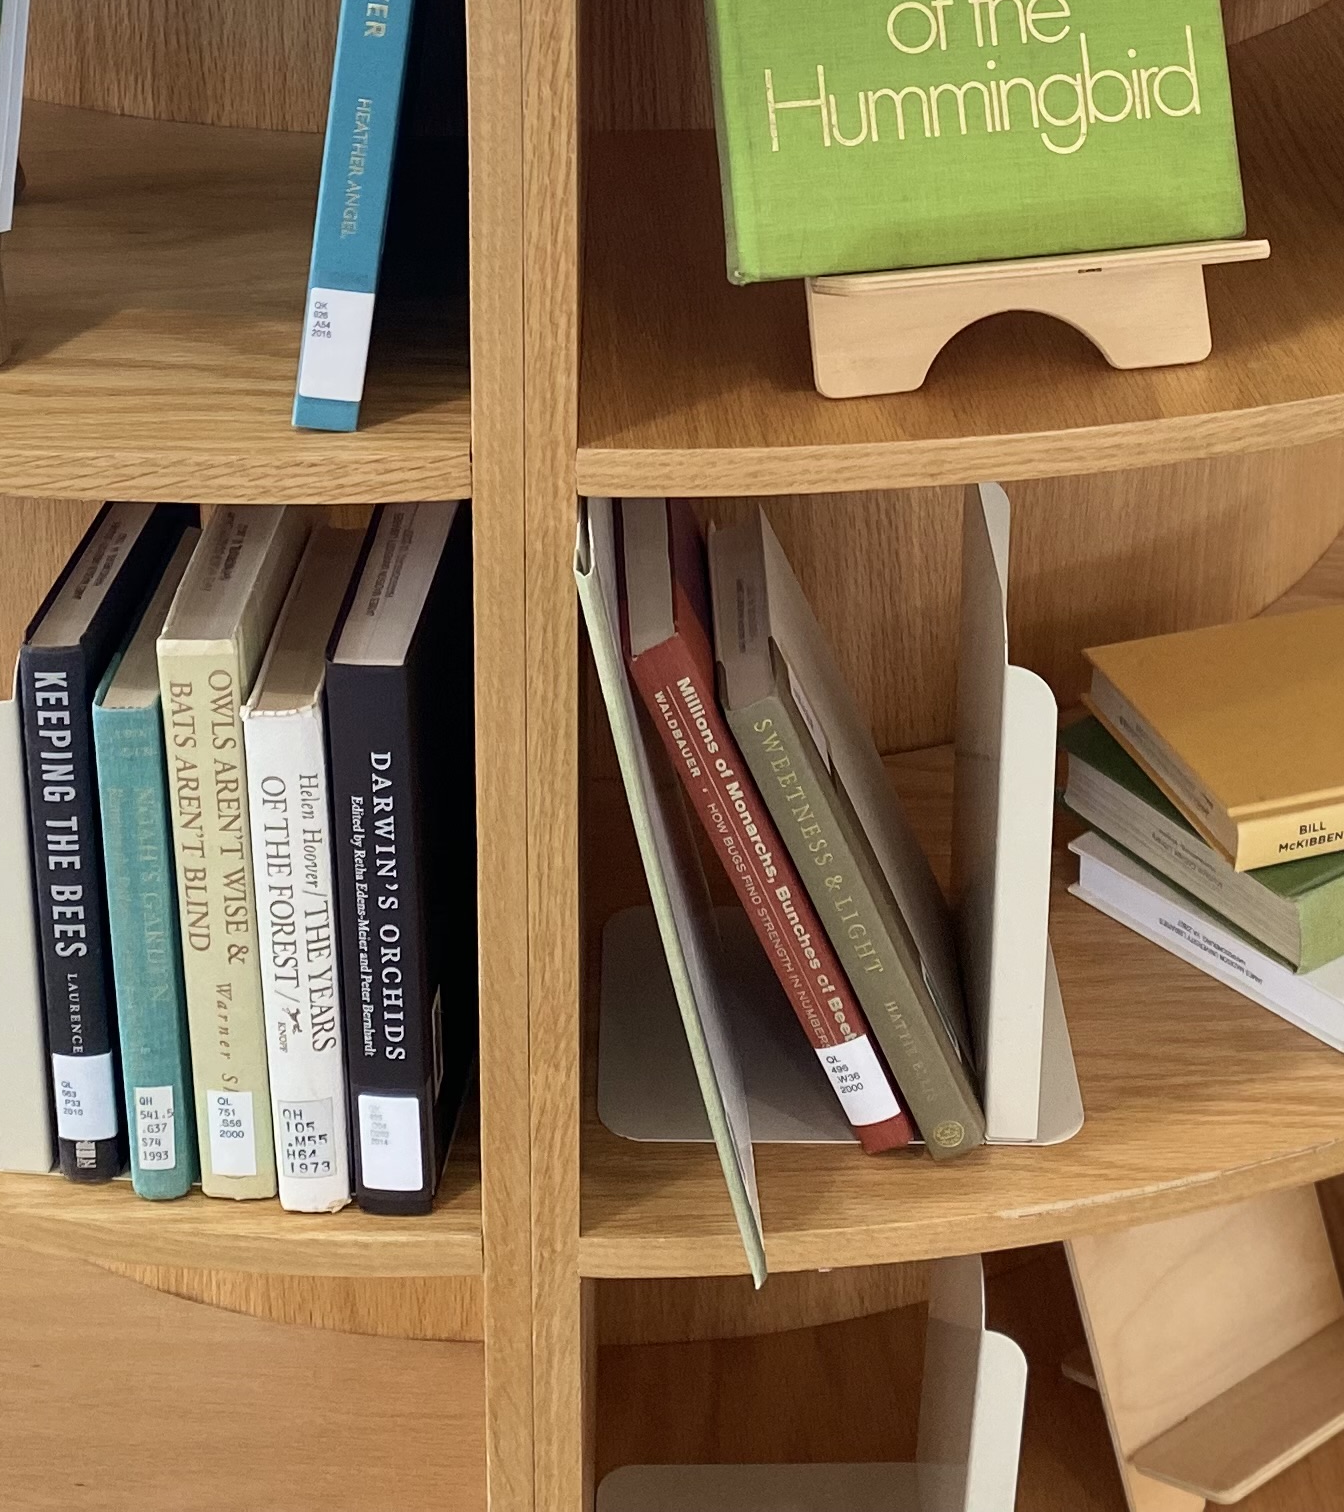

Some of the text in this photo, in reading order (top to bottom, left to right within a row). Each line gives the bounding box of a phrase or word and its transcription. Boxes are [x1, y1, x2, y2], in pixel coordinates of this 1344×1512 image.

[340, 98, 373, 240] HEATHER ANGEL
[765, 25, 1201, 155] Hummingbird
[33, 671, 88, 1053] KEEPING THE BEES LAURENCE
[170, 680, 211, 952] BATS AREN’T BLIND
[207, 669, 249, 964] OWLS AREN’T WISE &
[260, 776, 300, 993] OF THE FOREST
[299, 774, 337, 1054] Helen Hoover THE YEARS
[370, 752, 406, 1062] DARWIN’S ORCHIDS
[677, 676, 836, 993] Millions of Monarchs, Bunches of
[754, 718, 885, 976] SWEETNESS & LIGHT
[1278, 831, 1344, 853] McKIBBEN
[1299, 822, 1326, 836] BILL
[139, 1096, 154, 1107] QH
[142, 1136, 161, 1148] S74
[142, 1149, 169, 1163] 1993
